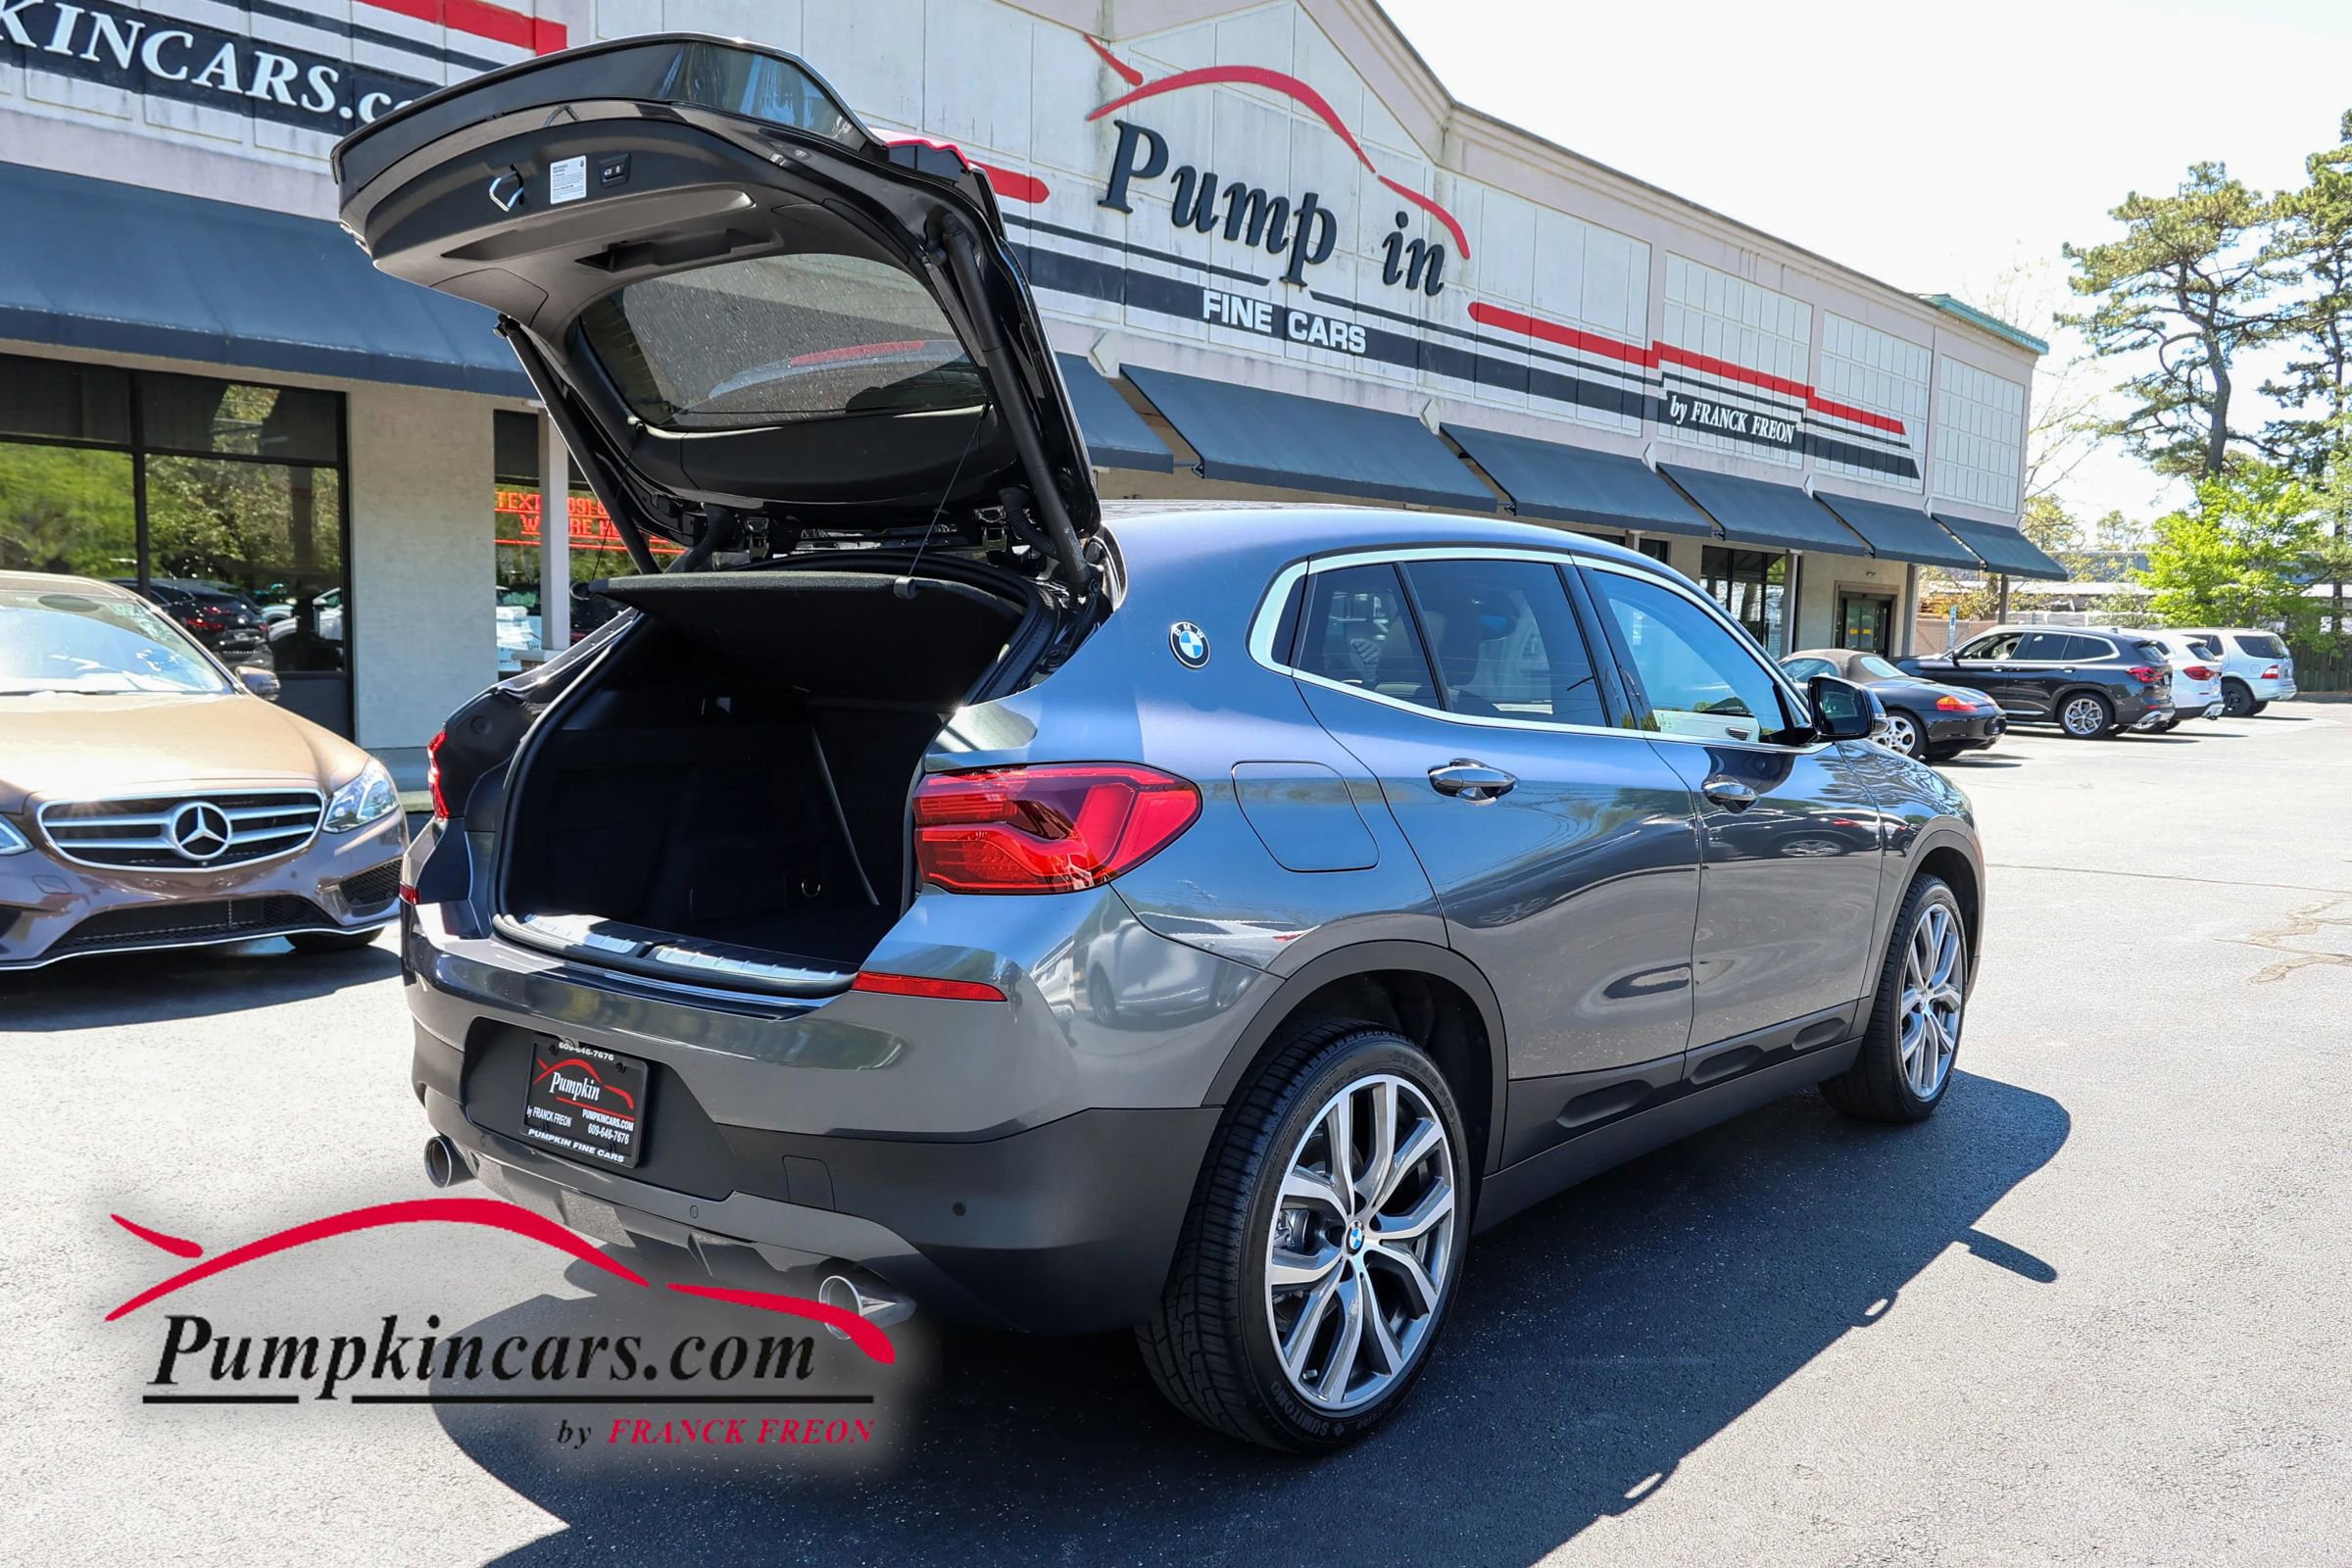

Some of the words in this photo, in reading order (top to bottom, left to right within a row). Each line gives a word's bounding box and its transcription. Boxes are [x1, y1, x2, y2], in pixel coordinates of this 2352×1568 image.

[0, 0, 415, 124] KINCARS.c
[1097, 119, 1338, 288] Pump
[1381, 211, 1446, 296] in
[1202, 289, 1273, 334] FINE
[1288, 311, 1366, 354] CARS
[1669, 394, 1688, 425] by
[1690, 401, 1749, 433] FRANCK
[1750, 415, 1795, 444] FREON
[494, 491, 541, 511] TEXT
[549, 1071, 600, 1101] Pumpkin
[526, 1105, 533, 1118] by
[532, 1106, 554, 1124] FRANCK
[553, 1111, 572, 1128] FREON
[582, 1108, 634, 1132] PUMPKINCARS.COM
[528, 1128, 570, 1147] PUMPKIN
[572, 1142, 596, 1154] FINE
[597, 1150, 625, 1163] CARS
[588, 1123, 630, 1145] 609-646-7676
